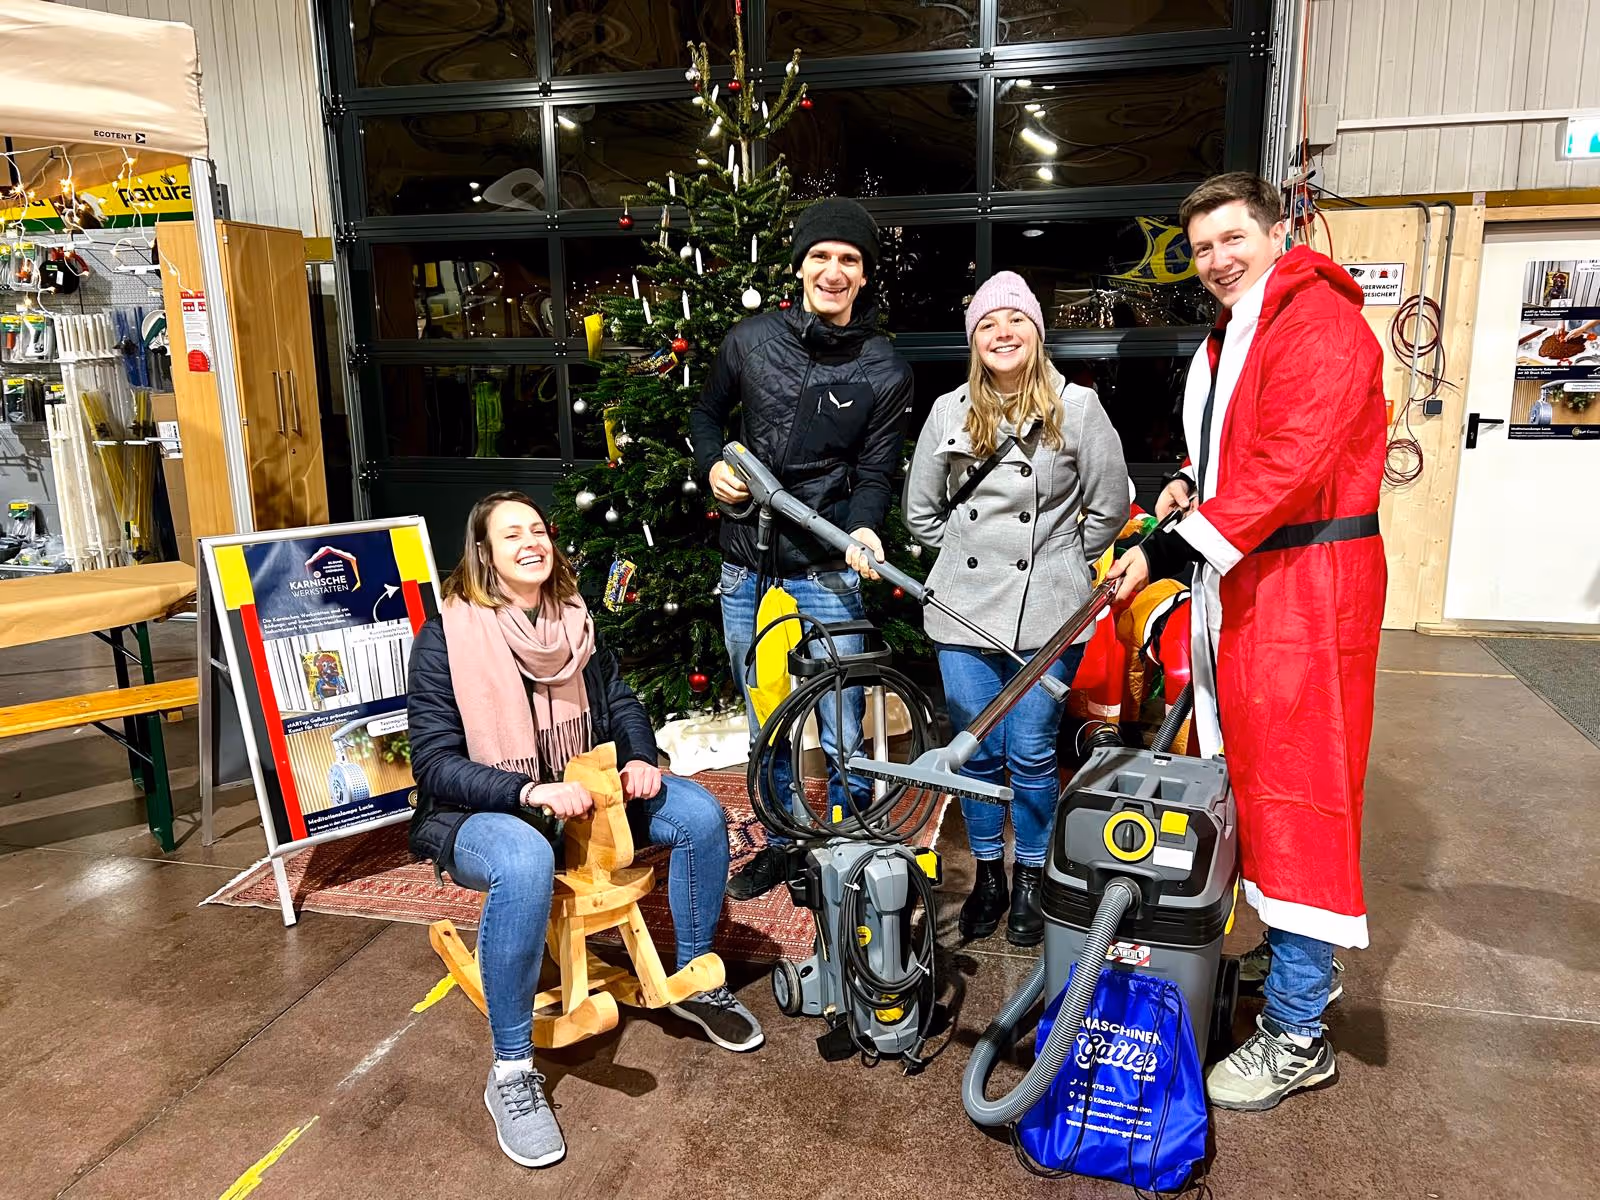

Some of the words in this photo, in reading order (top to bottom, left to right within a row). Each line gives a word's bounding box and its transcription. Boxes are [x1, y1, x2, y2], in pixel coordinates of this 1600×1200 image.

[94, 130, 132, 140] ECOTENT
[117, 184, 191, 208] patura
[289, 575, 347, 590] KARNISCHE
[1080, 1016, 1162, 1046] MASCHINEN
